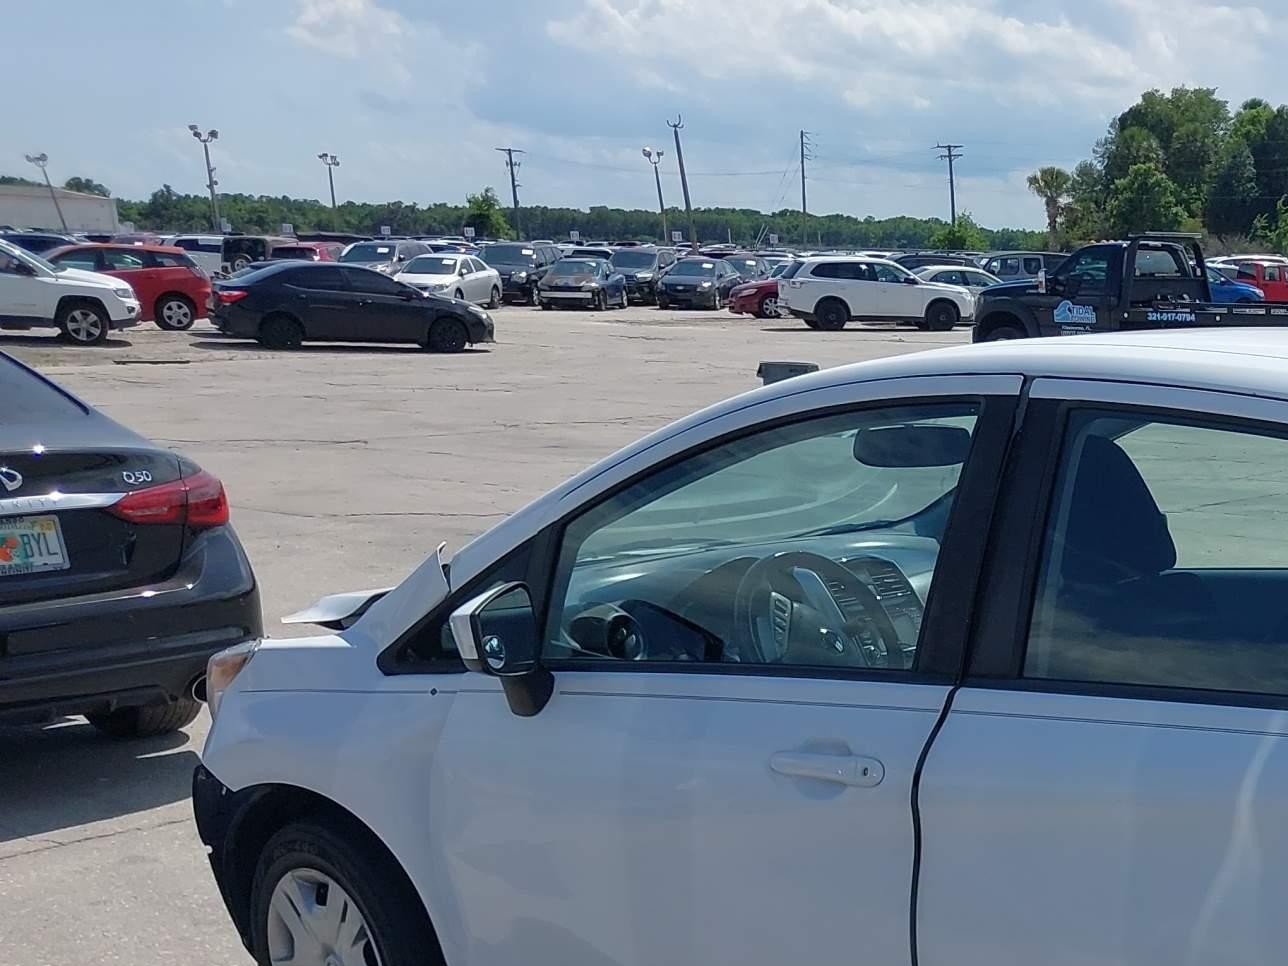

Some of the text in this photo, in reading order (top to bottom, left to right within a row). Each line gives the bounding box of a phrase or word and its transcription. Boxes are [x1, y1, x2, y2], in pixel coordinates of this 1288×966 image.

[1071, 304, 1094, 316] TIDAL
[122, 470, 152, 485] Q50
[20, 532, 58, 559] BYL
